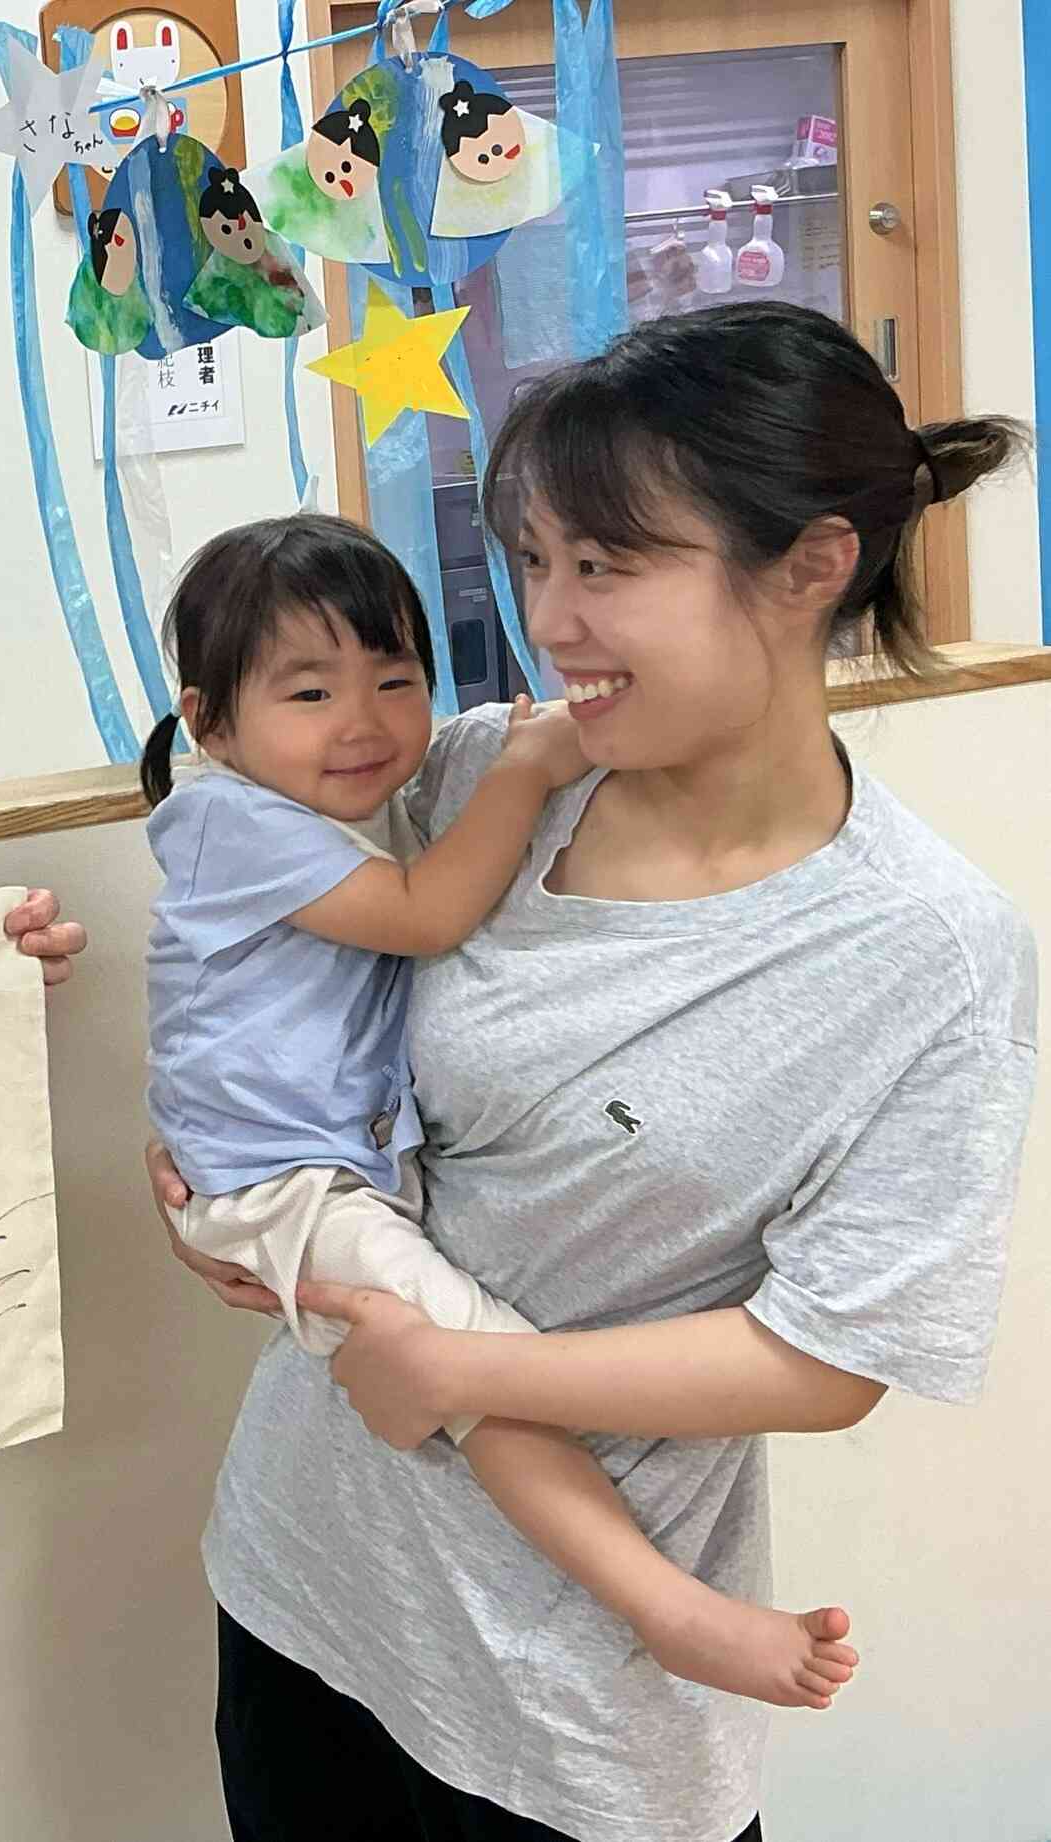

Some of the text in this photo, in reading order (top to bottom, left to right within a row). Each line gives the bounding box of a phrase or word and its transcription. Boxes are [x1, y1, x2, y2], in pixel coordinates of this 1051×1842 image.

[19, 112, 103, 154] さなちゃん
[189, 400, 220, 413] ニチイ
